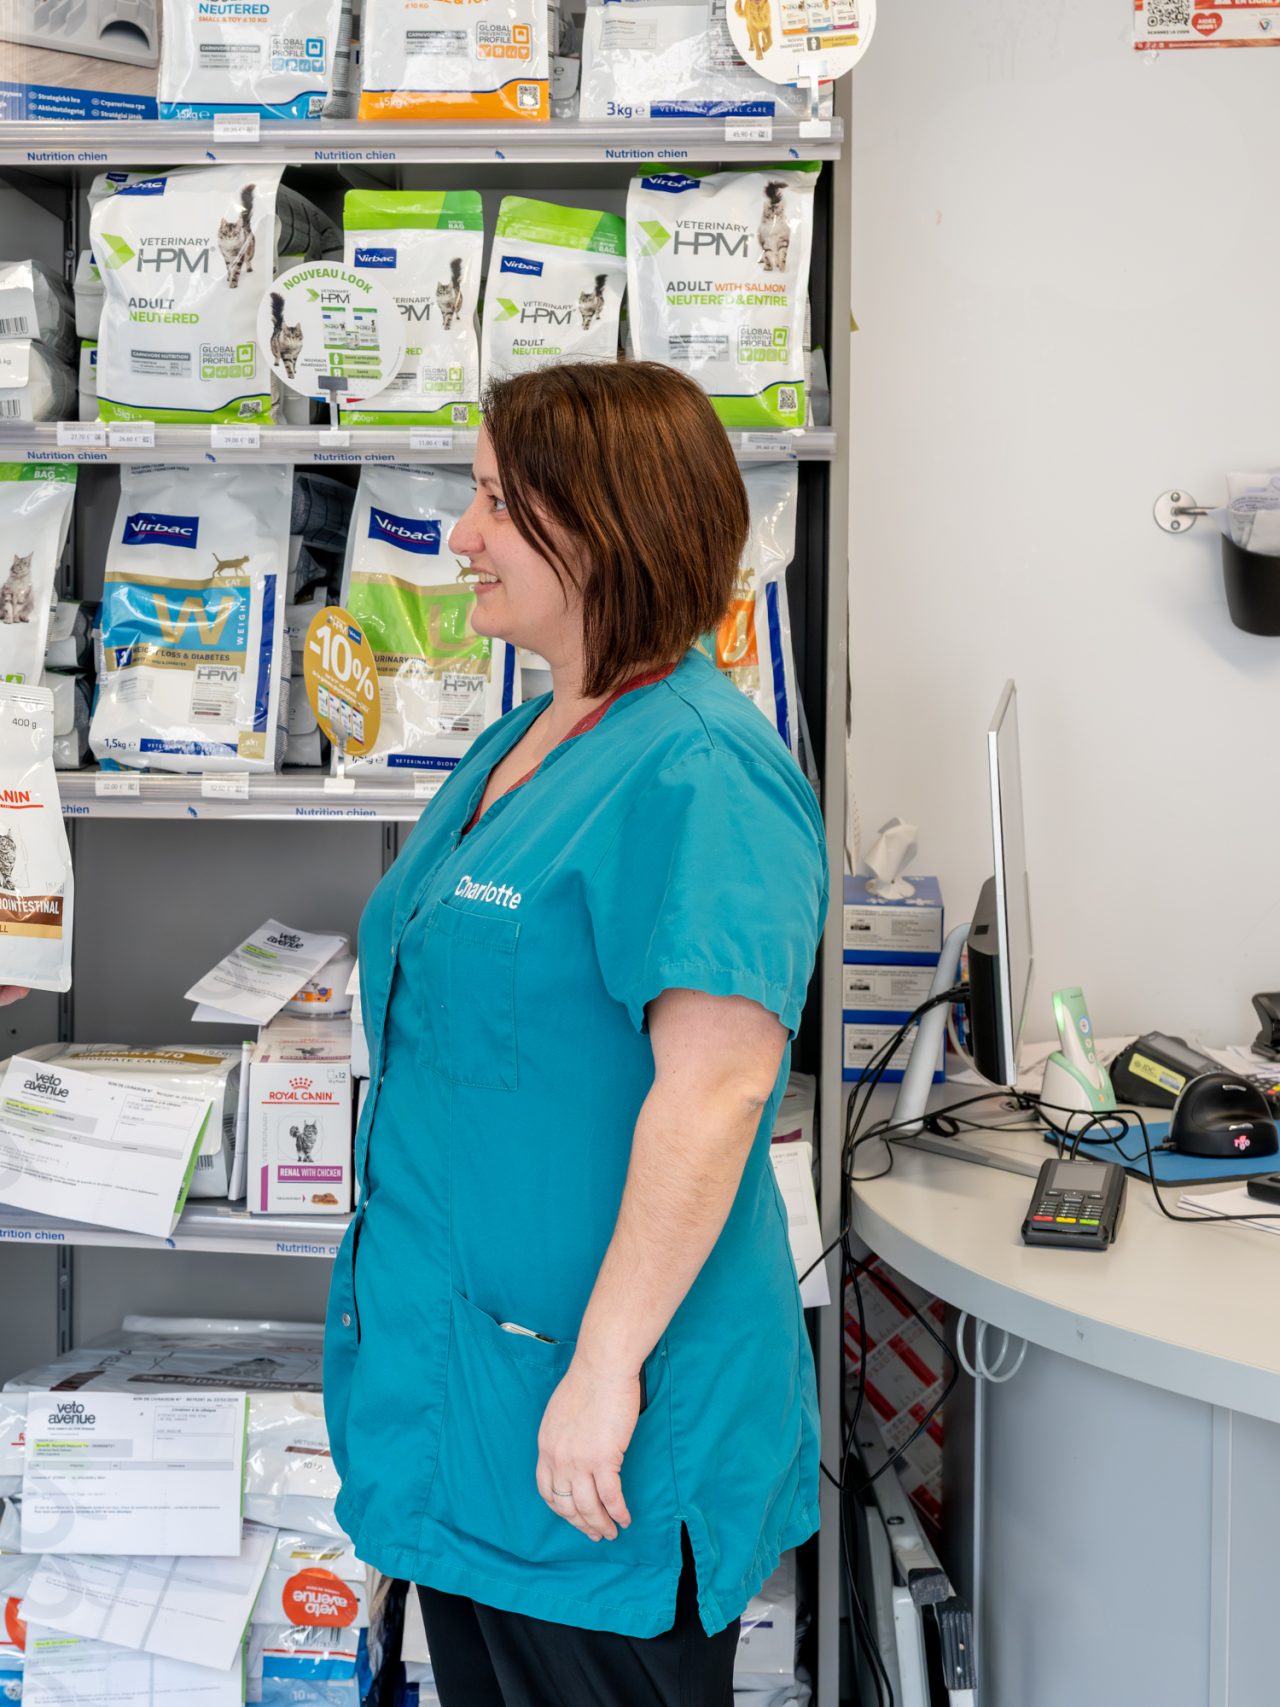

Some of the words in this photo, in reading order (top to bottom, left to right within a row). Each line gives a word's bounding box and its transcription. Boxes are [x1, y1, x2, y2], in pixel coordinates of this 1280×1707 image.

[198, 3, 270, 15] NEUTERED
[747, 106, 768, 114] CARE
[27, 152, 75, 161] Nutrition
[78, 152, 108, 161] chien
[314, 151, 362, 160] Nutrition
[366, 151, 396, 160] chien
[605, 149, 655, 159] Nutrition
[657, 149, 688, 159] chien
[676, 220, 749, 232] VETERINARY
[140, 237, 210, 247] VETERINARY
[673, 231, 749, 257] HPM
[137, 248, 210, 273] HPM
[357, 253, 394, 263] Virbac
[504, 260, 541, 273] Virbac
[283, 268, 339, 290] NOUVEAU
[340, 270, 374, 294] LOOK
[666, 281, 713, 292] ADULT
[715, 283, 743, 292] WITH
[745, 284, 786, 293] SALMON
[129, 297, 175, 309] ADULT
[320, 293, 350, 304] HPM
[523, 301, 573, 311] VETERINARY
[129, 311, 200, 324] NEUTERED
[520, 308, 572, 325] HPM
[512, 338, 545, 347] ADULT
[512, 348, 562, 356] NEUTERED
[27, 451, 75, 460] Nutrition
[78, 451, 108, 460] chien
[314, 452, 362, 461] Nutrition
[365, 452, 395, 461] chien
[34, 471, 55, 479] BAG
[131, 520, 193, 536] Virbac
[375, 514, 437, 542] Virbac
[225, 579, 241, 587] CAT
[152, 593, 234, 645] W
[236, 597, 247, 646] WEIGHT
[161, 651, 182, 659] LOSS
[192, 653, 230, 661] DIABETES
[310, 624, 374, 701] -10%
[197, 670, 238, 682] HPM
[12, 717, 30, 728] 400
[31, 720, 37, 730] g
[395, 758, 435, 766] VETERINARY
[61, 804, 90, 814] chien
[295, 807, 344, 816] Nutrition
[346, 808, 377, 817] chien
[455, 875, 521, 909] Charlotte
[35, 1072, 62, 1086] veto
[24, 1079, 70, 1098] avenue
[269, 1092, 298, 1101] ROYAL
[301, 1092, 333, 1101] CANIN
[280, 1168, 300, 1177] RENAL
[301, 1168, 316, 1177] WITH
[317, 1168, 342, 1177] CHICKEN
[35, 1230, 65, 1241] chien
[276, 1242, 326, 1254] Nutrition
[56, 1402, 85, 1413] veto
[48, 1412, 96, 1425] avenue
[293, 1590, 348, 1608] avenue
[305, 1602, 339, 1617] veto
